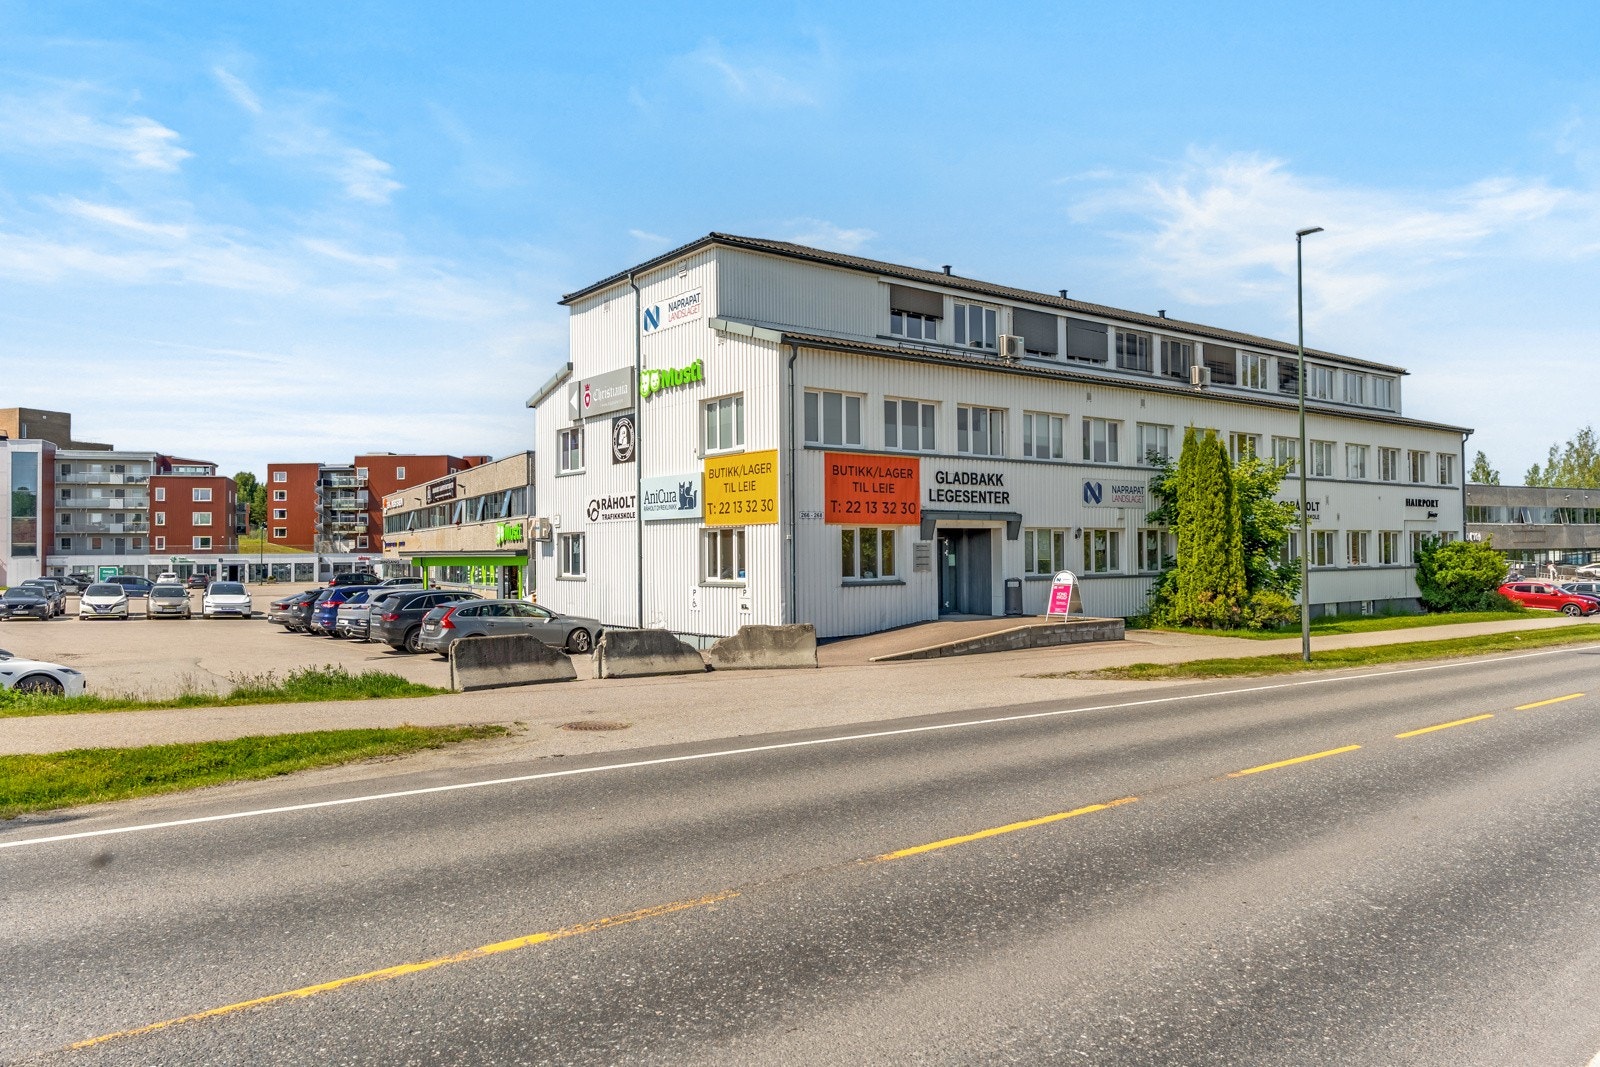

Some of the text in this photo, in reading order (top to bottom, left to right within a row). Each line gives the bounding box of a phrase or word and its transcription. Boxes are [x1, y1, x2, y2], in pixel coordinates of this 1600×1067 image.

[668, 292, 701, 312] NAPRAPAT
[668, 303, 701, 322] LANDSLAGET
[661, 359, 702, 389] Musti
[708, 462, 772, 479] BUTIKK/LAGER
[832, 464, 914, 479] BUTIKK/LAGER
[935, 470, 1004, 487] GLADBAKK
[723, 480, 756, 493] TIL LEIE
[852, 481, 896, 494] TIL LEIE
[1111, 485, 1145, 495] NAPRAPAT
[601, 495, 636, 510] RÅHOLT
[643, 489, 677, 505] AniCura
[928, 488, 1010, 505] LEGESENTER
[1111, 494, 1145, 504] LANDSLAGET
[1405, 498, 1439, 508] HAIRPORT
[707, 498, 774, 515] T: 22 13 32 30
[831, 500, 917, 515] T: 22 13 32 30
[602, 512, 636, 520] TRAFIKKSKOLE
